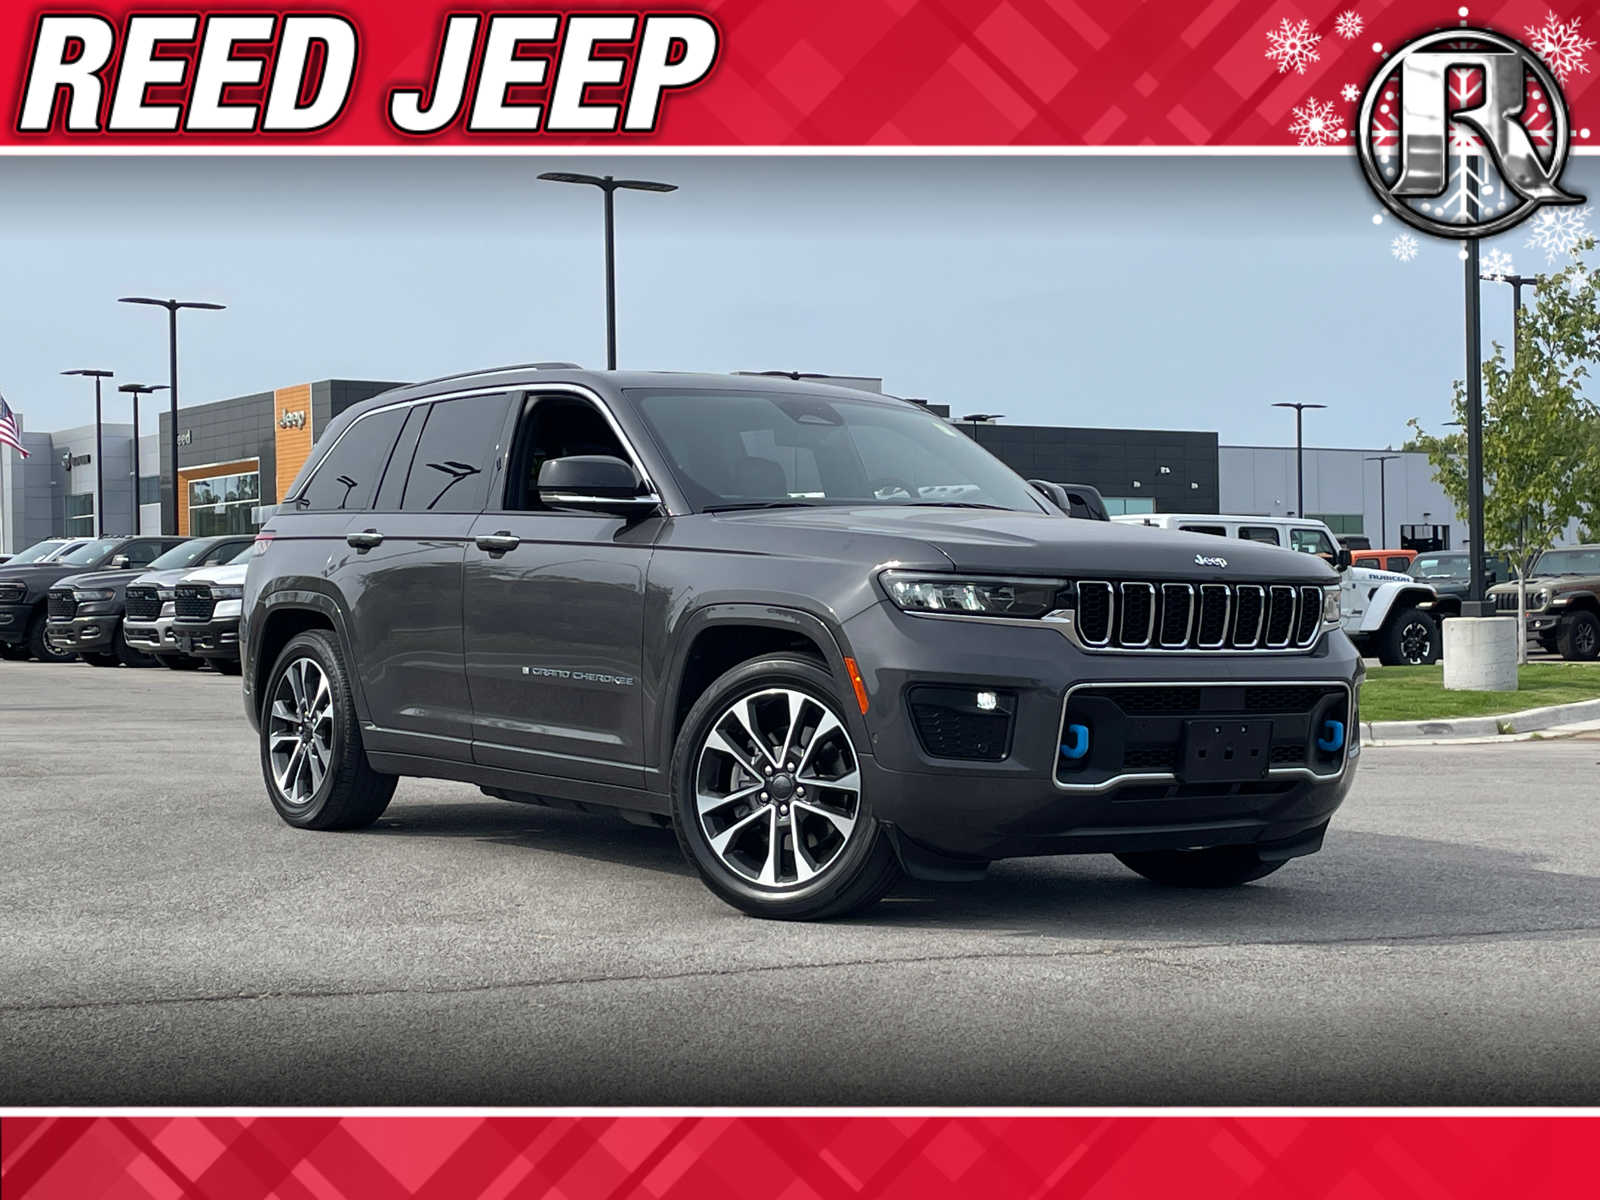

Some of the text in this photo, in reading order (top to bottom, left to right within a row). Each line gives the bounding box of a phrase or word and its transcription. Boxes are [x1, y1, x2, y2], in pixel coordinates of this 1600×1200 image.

[280, 407, 305, 429] Jeep
[1194, 554, 1228, 568] Jeep
[1368, 573, 1410, 582] RUBICON
[532, 667, 634, 685] GRAND CHEROKEE
